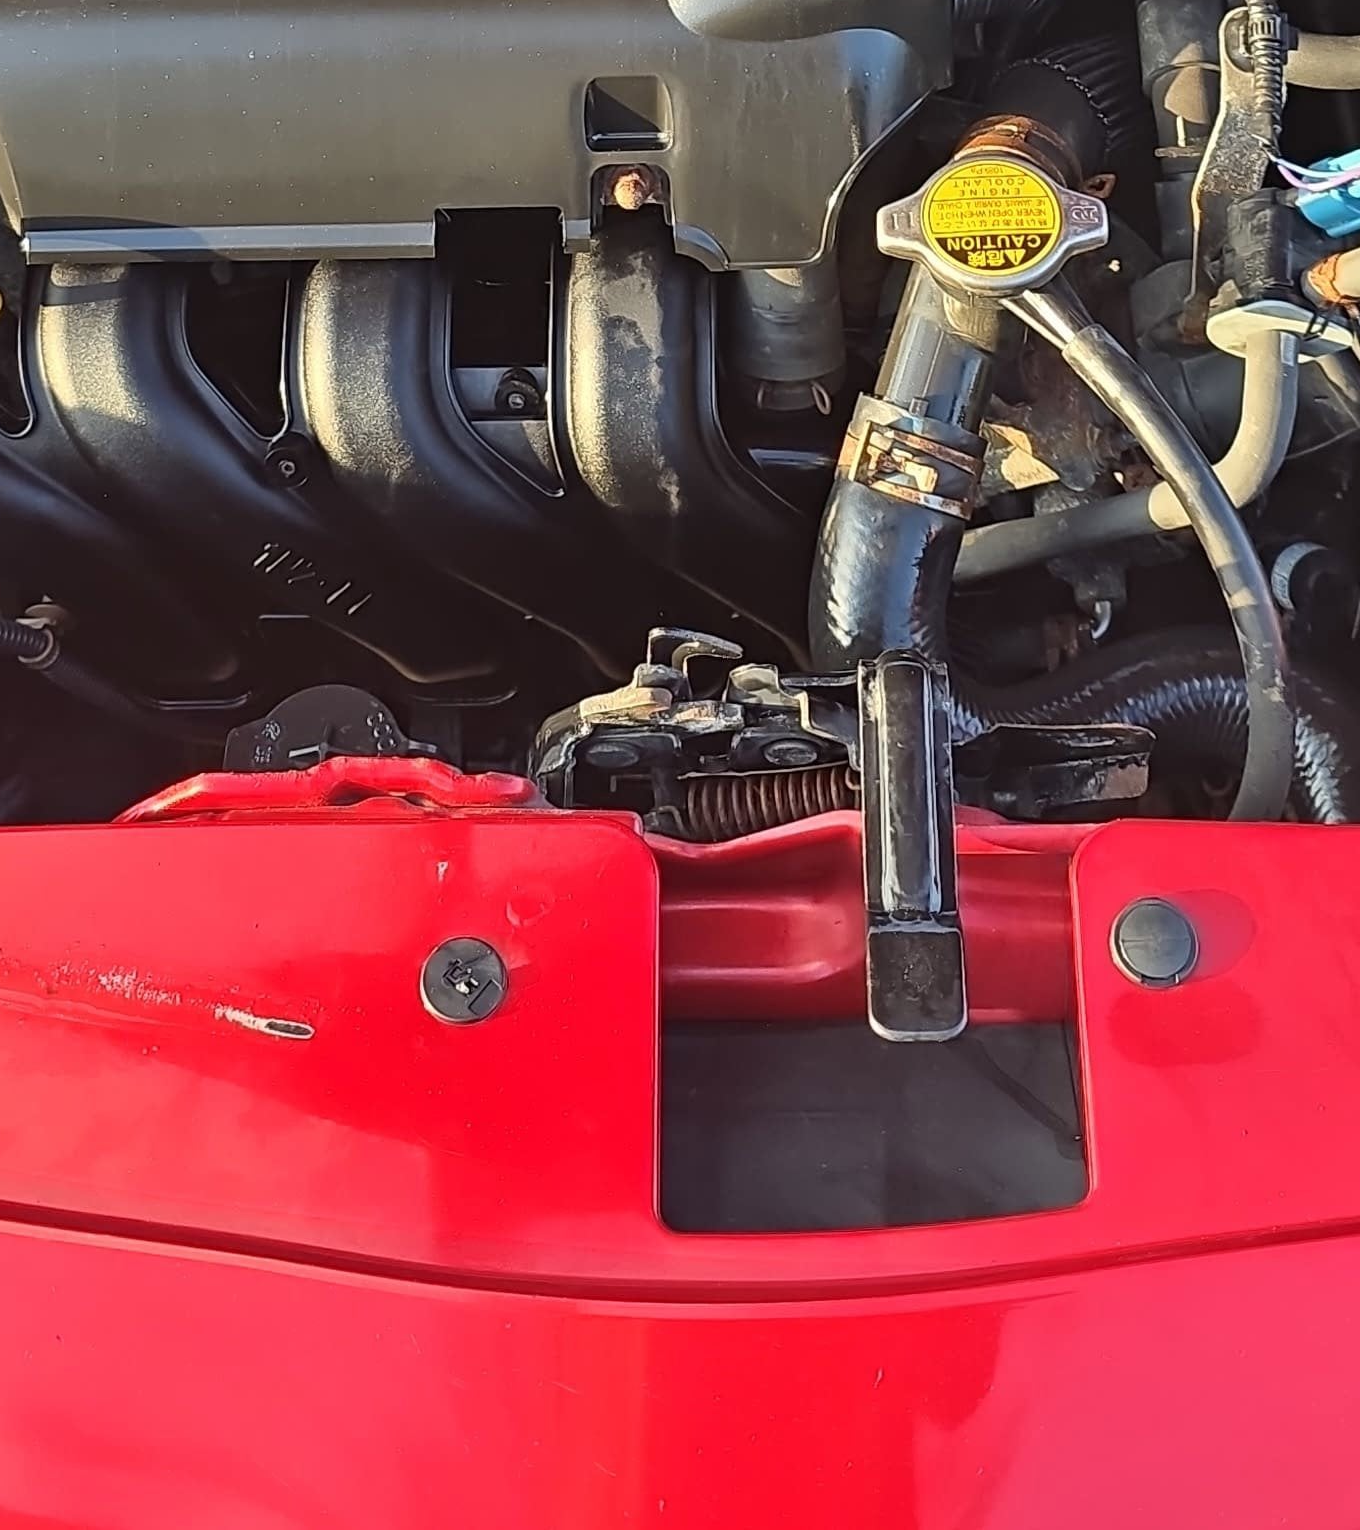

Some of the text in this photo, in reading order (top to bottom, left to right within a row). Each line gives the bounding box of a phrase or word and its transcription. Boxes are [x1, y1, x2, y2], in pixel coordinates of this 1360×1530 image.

[951, 178, 1026, 188] COOLANT
[958, 186, 1021, 197] ENGINE
[988, 209, 1014, 219] OPEN
[1016, 208, 1047, 218] NEVER
[946, 234, 1042, 252] CAUTION
